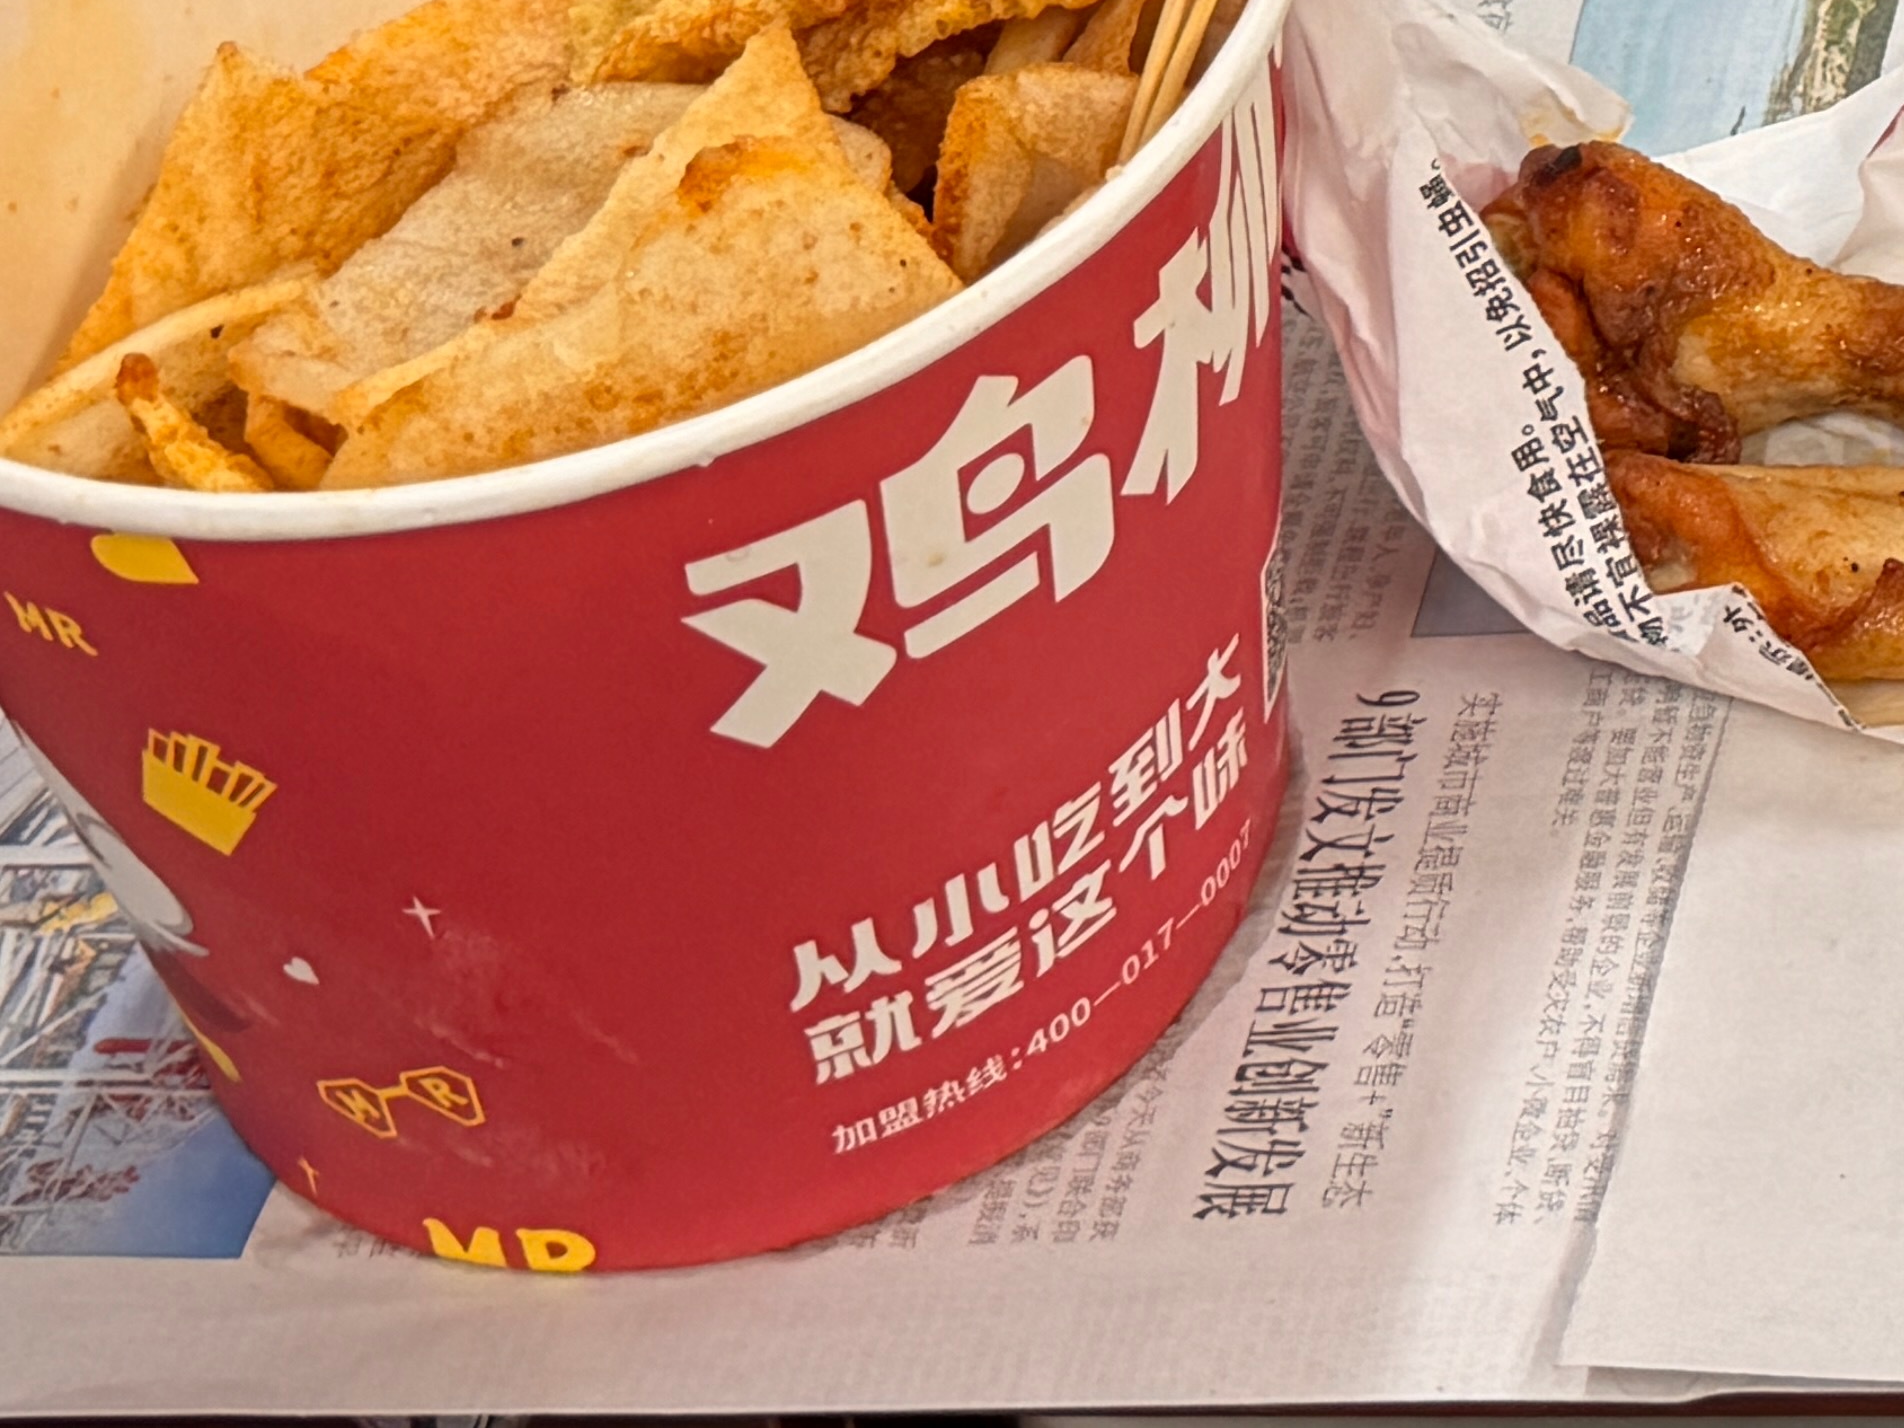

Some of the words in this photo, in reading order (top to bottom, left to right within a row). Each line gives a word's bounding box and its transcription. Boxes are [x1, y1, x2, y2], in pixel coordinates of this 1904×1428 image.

[4, 590, 98, 657] MR
[790, 632, 1243, 1014] 从小吃到大
[806, 711, 1247, 1086] 就爱这个味
[1191, 674, 1425, 1242] 9部门发文推动零售业创新发展
